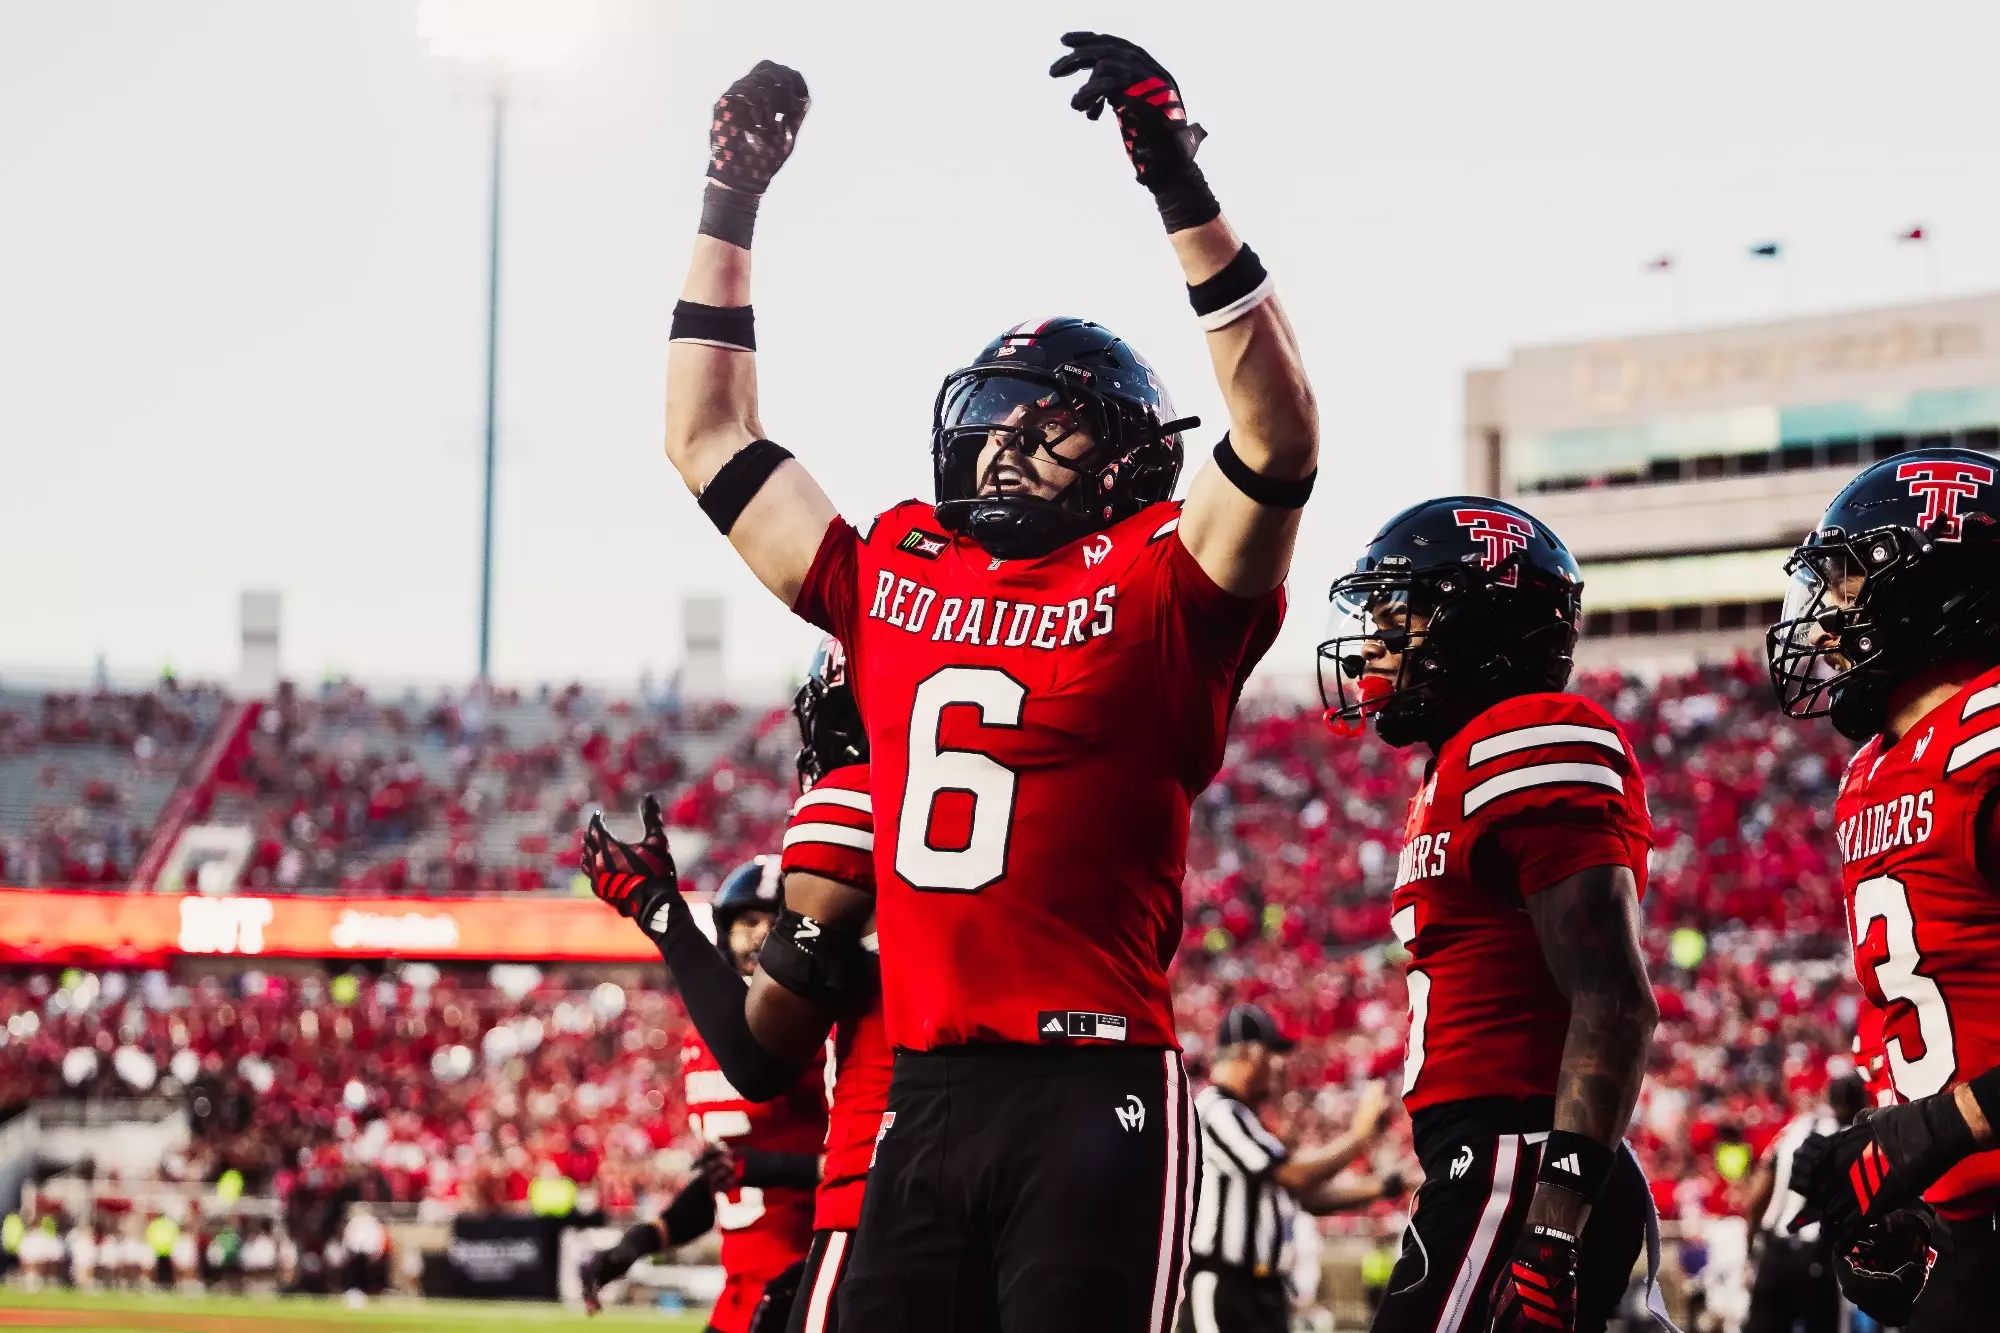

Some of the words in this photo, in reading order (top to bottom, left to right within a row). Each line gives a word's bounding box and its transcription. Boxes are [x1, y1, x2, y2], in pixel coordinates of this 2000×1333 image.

[1064, 364, 1081, 375] GUNS
[1082, 370, 1092, 378] UP
[868, 569, 938, 634] RED
[930, 583, 1118, 650] RAIDERS
[894, 663, 1030, 894] 6
[1080, 1021, 1086, 1032] L
